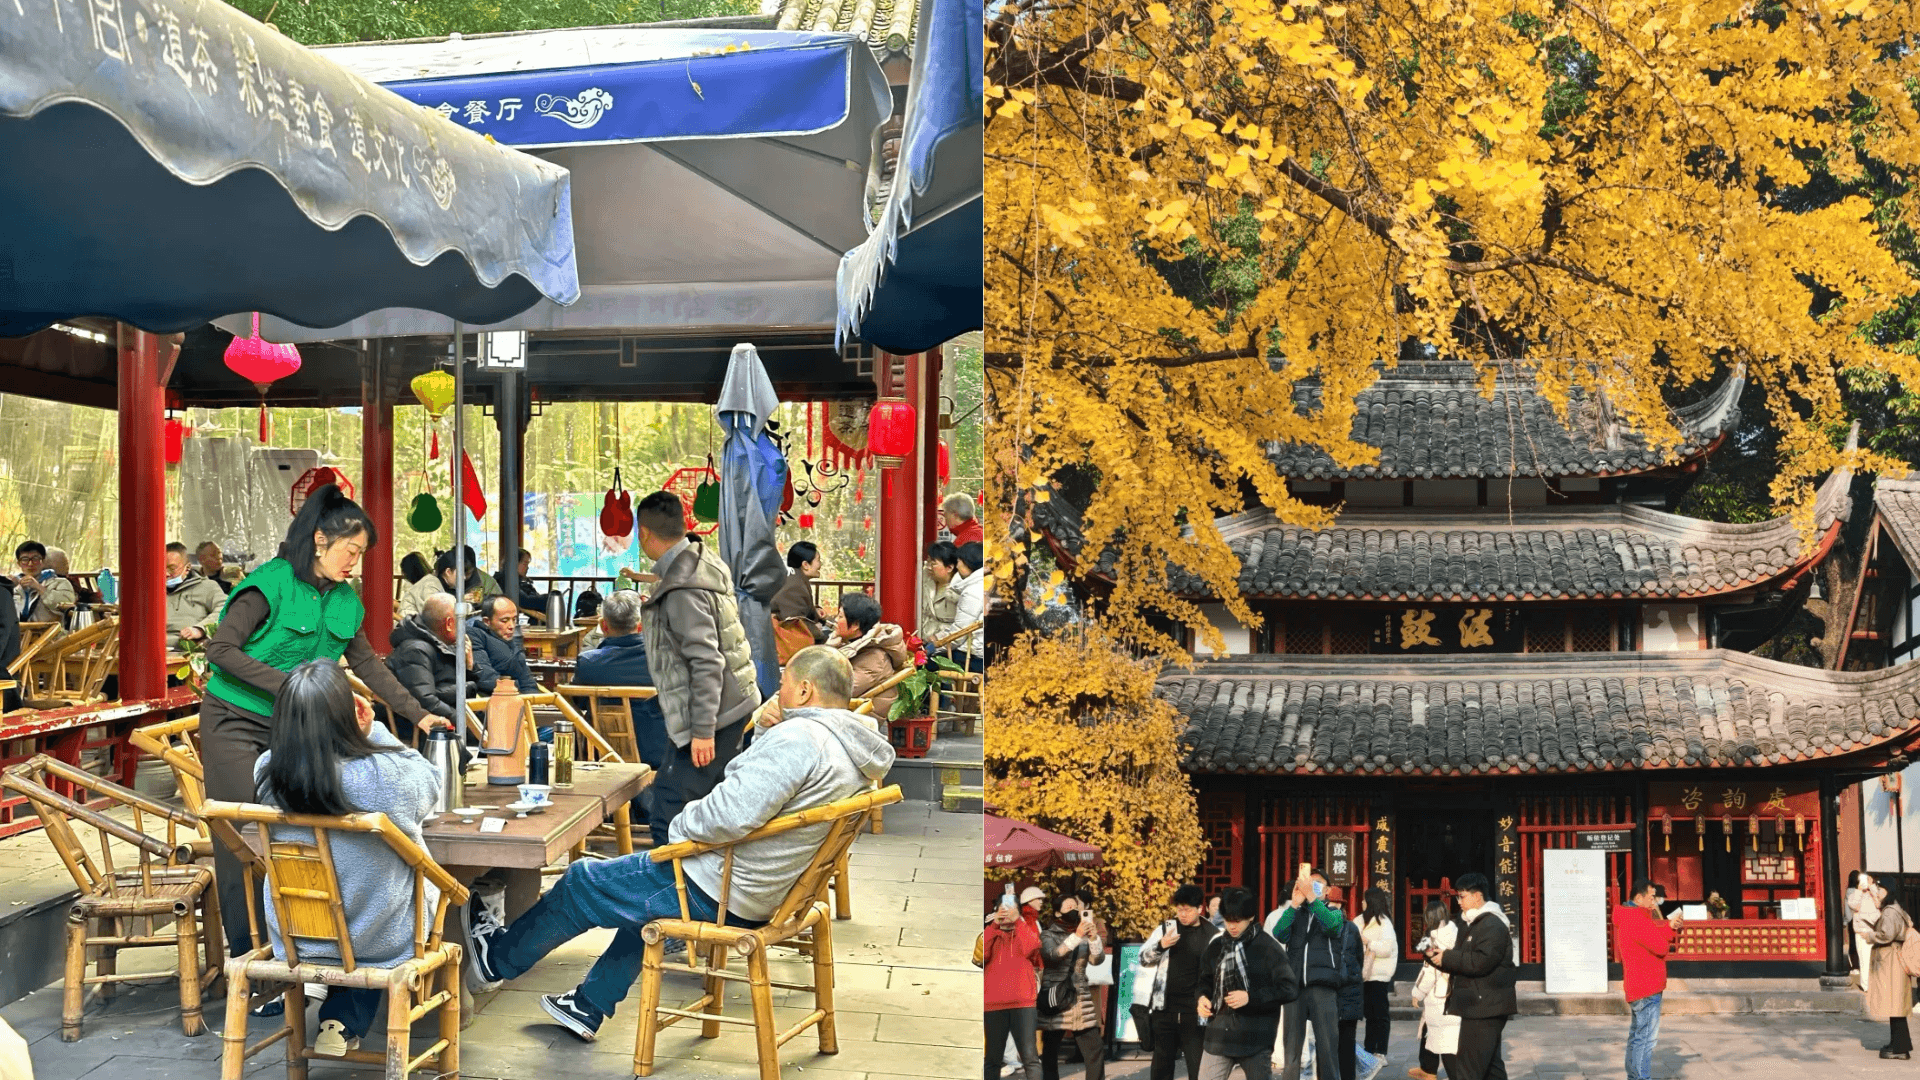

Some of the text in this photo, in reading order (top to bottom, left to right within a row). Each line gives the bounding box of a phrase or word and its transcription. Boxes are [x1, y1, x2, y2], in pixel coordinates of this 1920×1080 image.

[1682, 786, 1791, 812] 咨詢處
[1333, 842, 1348, 874] 鼓楼
